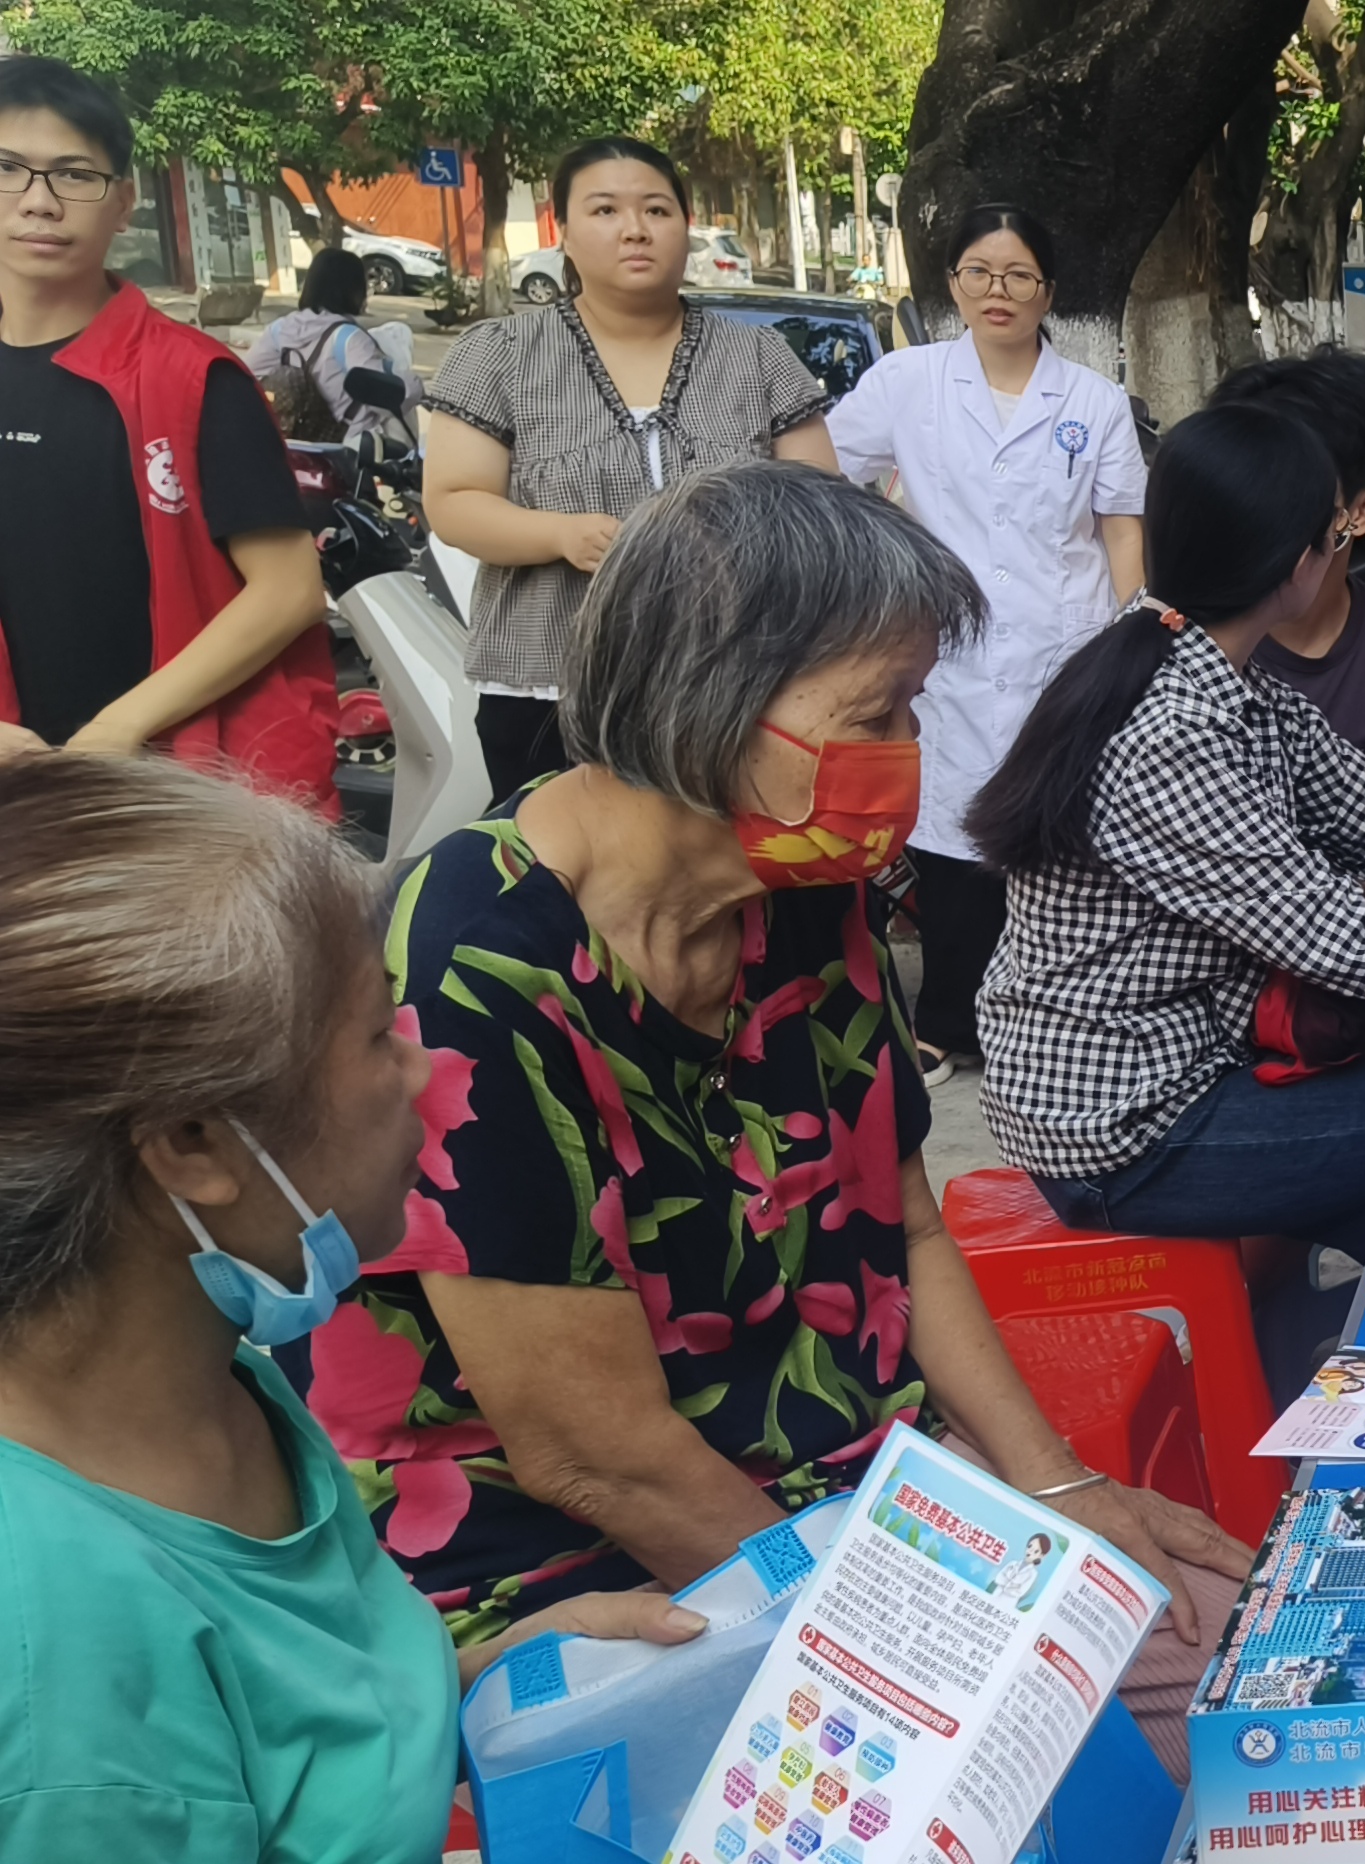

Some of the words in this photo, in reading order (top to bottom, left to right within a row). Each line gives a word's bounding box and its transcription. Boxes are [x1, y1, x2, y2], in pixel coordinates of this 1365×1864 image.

[891, 1482, 1010, 1564] 国家免费基本公共卫生
[794, 1651, 921, 1742] 国家基本公共卫生服务项目有14项内容
